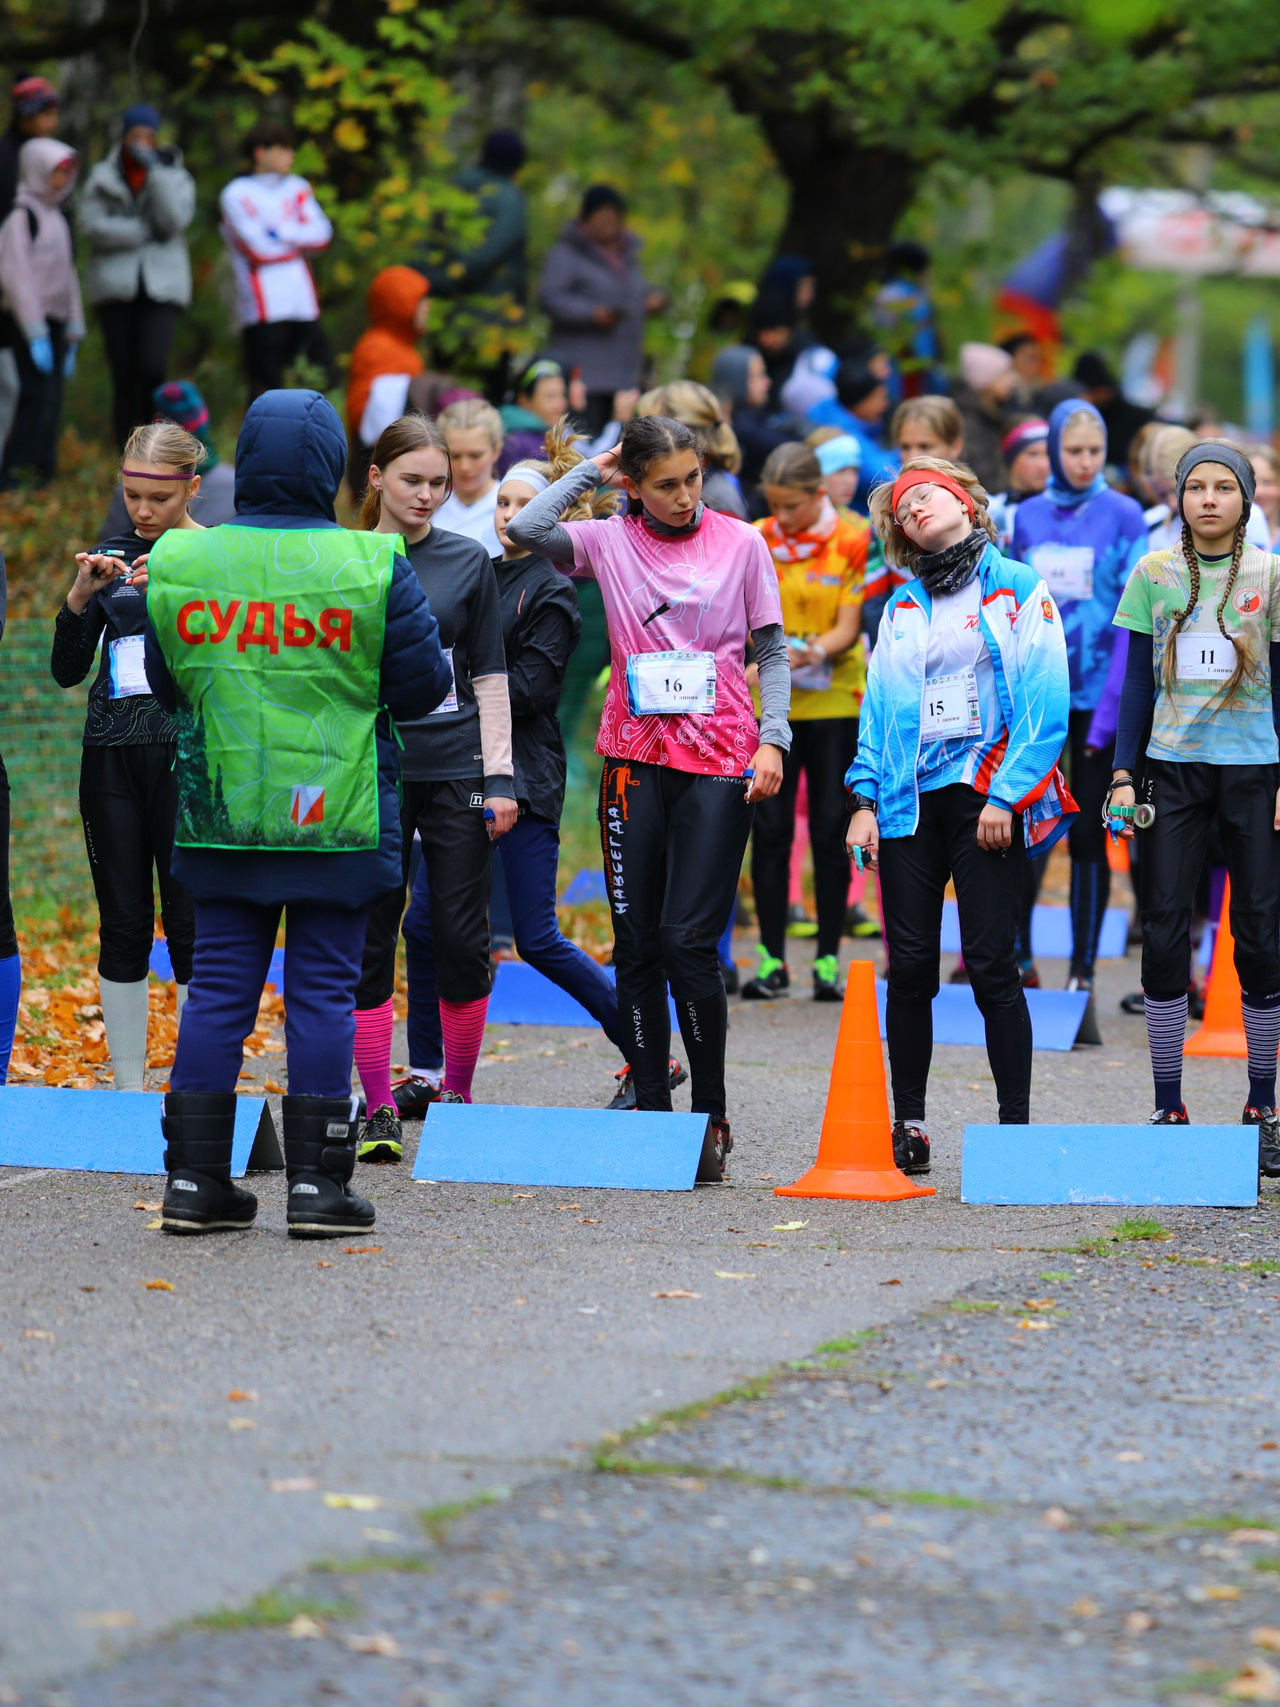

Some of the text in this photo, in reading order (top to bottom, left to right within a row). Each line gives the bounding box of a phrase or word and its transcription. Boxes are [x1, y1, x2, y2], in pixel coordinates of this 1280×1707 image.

[176, 600, 353, 655] СУДЬЯ
[1200, 650, 1215, 665] 11
[664, 678, 683, 693] 16
[929, 700, 945, 716] 15
[608, 806, 630, 915] НАВСЕГДА
